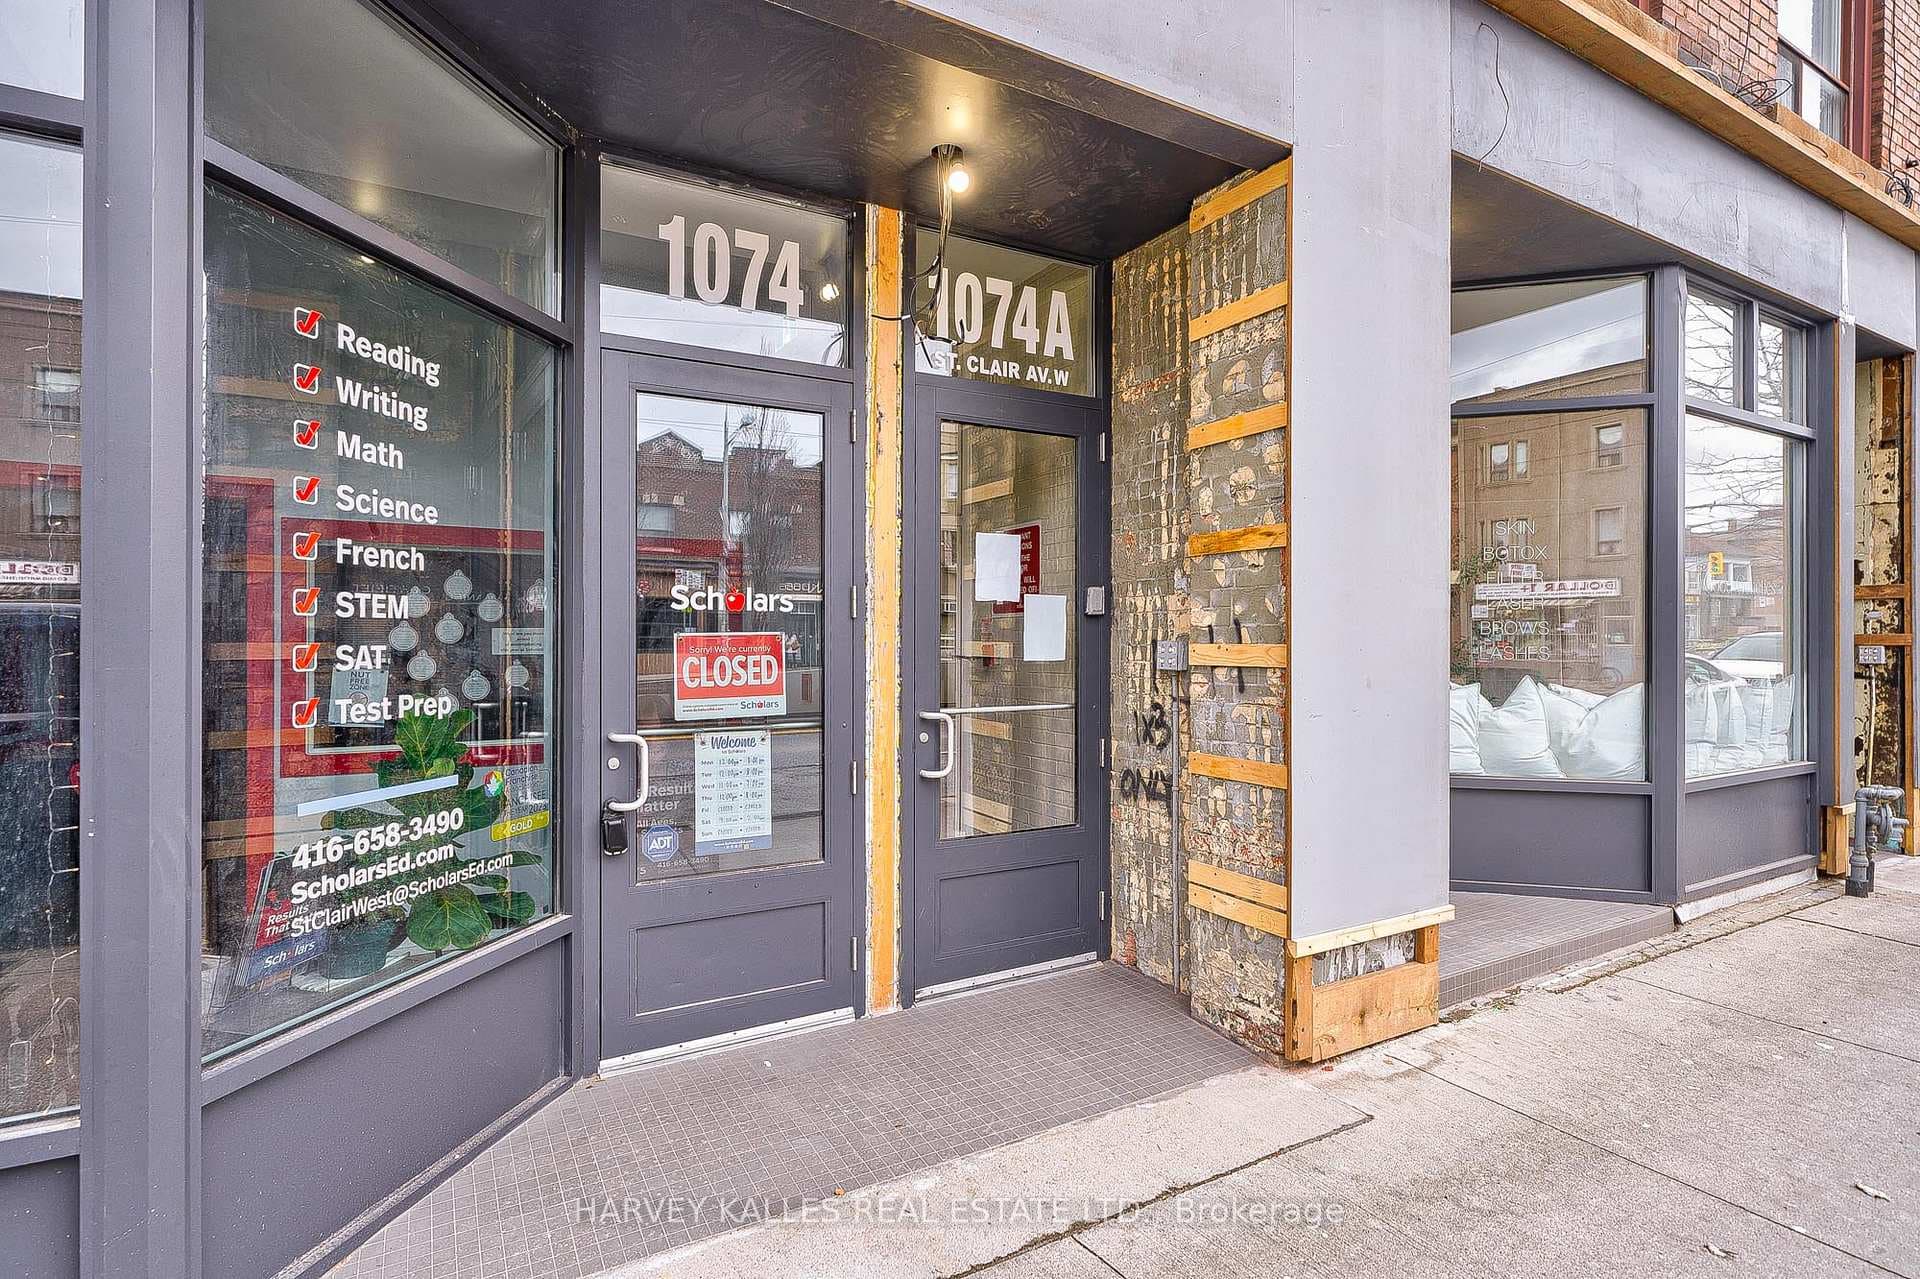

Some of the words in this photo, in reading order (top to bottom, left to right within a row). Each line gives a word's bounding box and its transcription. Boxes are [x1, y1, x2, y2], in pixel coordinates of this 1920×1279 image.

[658, 215, 804, 317] 1074
[928, 268, 1074, 360] 1074A
[337, 322, 441, 388] Reading
[967, 355, 1020, 380] CLAIR
[336, 376, 428, 432] Writing
[337, 430, 403, 470] Math
[336, 484, 439, 525] Science
[1495, 521, 1536, 536] SKIN
[336, 538, 425, 572] French
[1483, 545, 1549, 561] BOTOX
[335, 592, 409, 619] STEM
[1480, 620, 1549, 635] BROWS
[335, 645, 387, 671] SAT
[739, 645, 771, 653] currently
[1480, 646, 1550, 661] LASHES
[682, 655, 778, 688] CLOSED
[335, 696, 392, 724] Test
[399, 694, 451, 720] Prep
[711, 735, 757, 749] Welcome
[291, 808, 464, 870] 416-658-3490
[510, 819, 533, 833] GOLD
[649, 836, 672, 850] ADT
[291, 844, 454, 904] ScholarsEd.com
[291, 853, 513, 938] StClairWest@ScholarsEd.com
